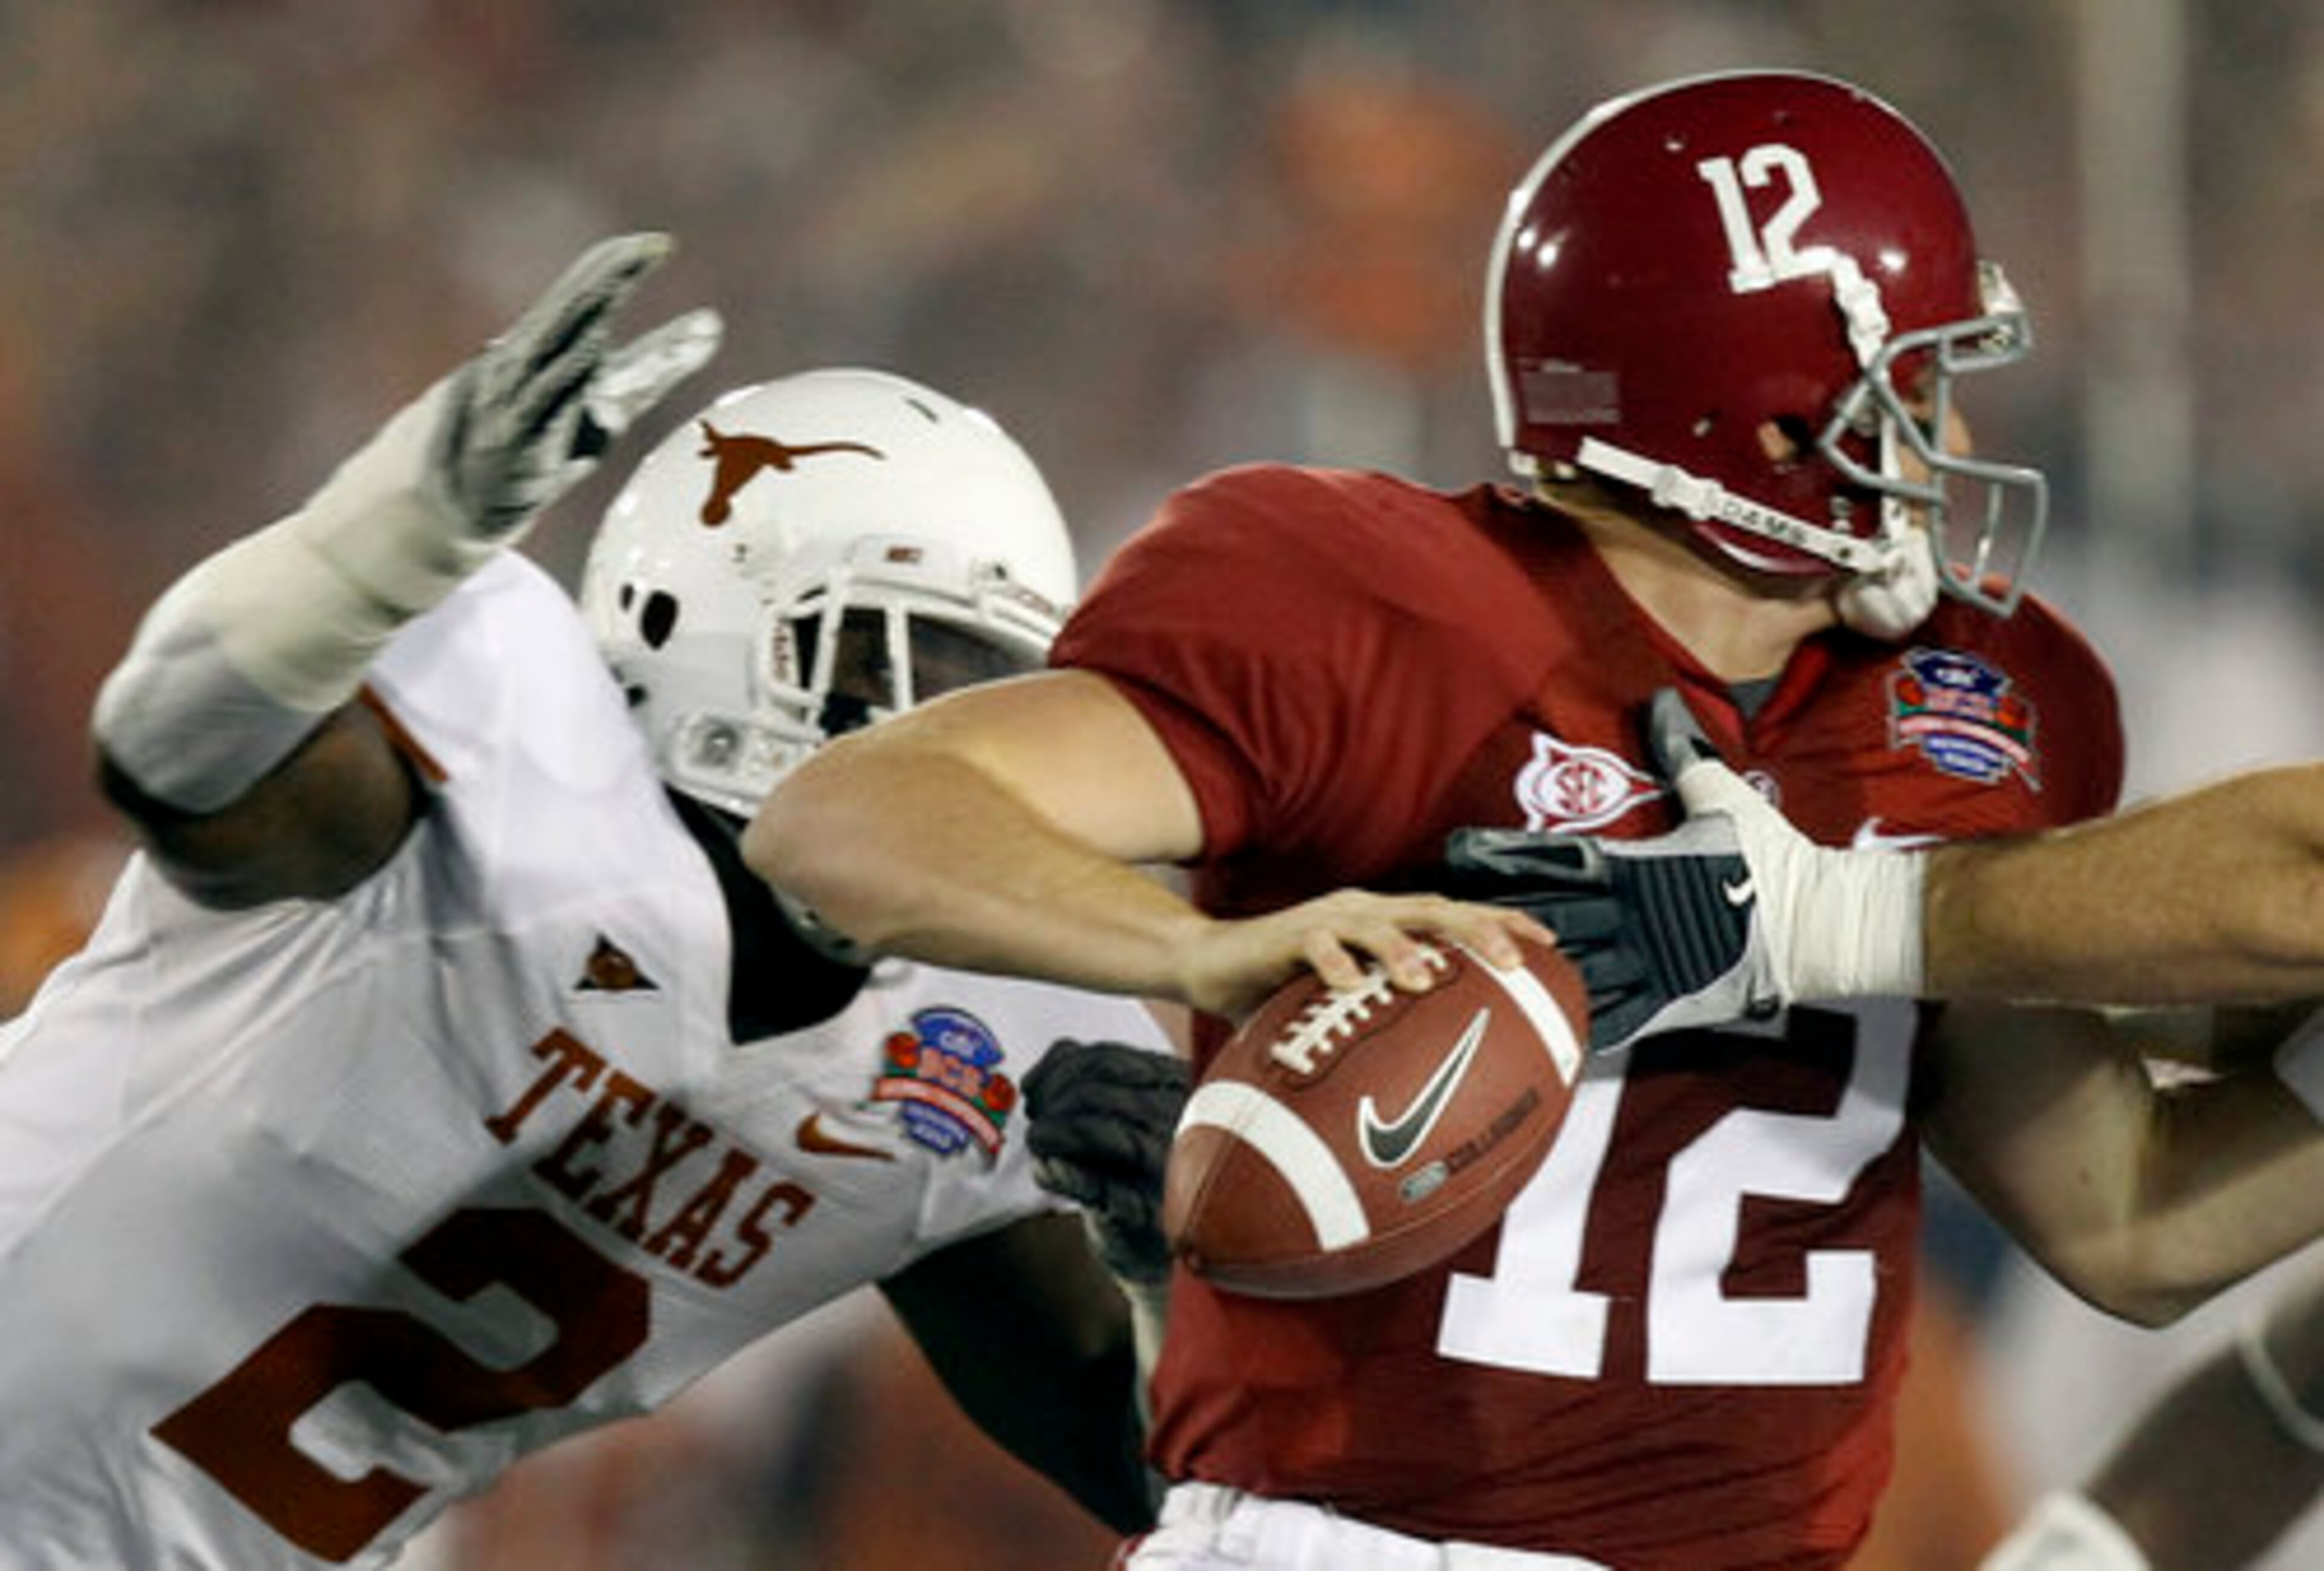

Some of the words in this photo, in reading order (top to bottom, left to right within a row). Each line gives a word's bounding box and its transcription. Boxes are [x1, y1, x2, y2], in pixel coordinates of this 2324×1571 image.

[1698, 144, 1837, 294] 12
[484, 1027, 815, 1288] TEXAS
[1437, 997, 1919, 1384] 12
[149, 1207, 651, 1564] 2
